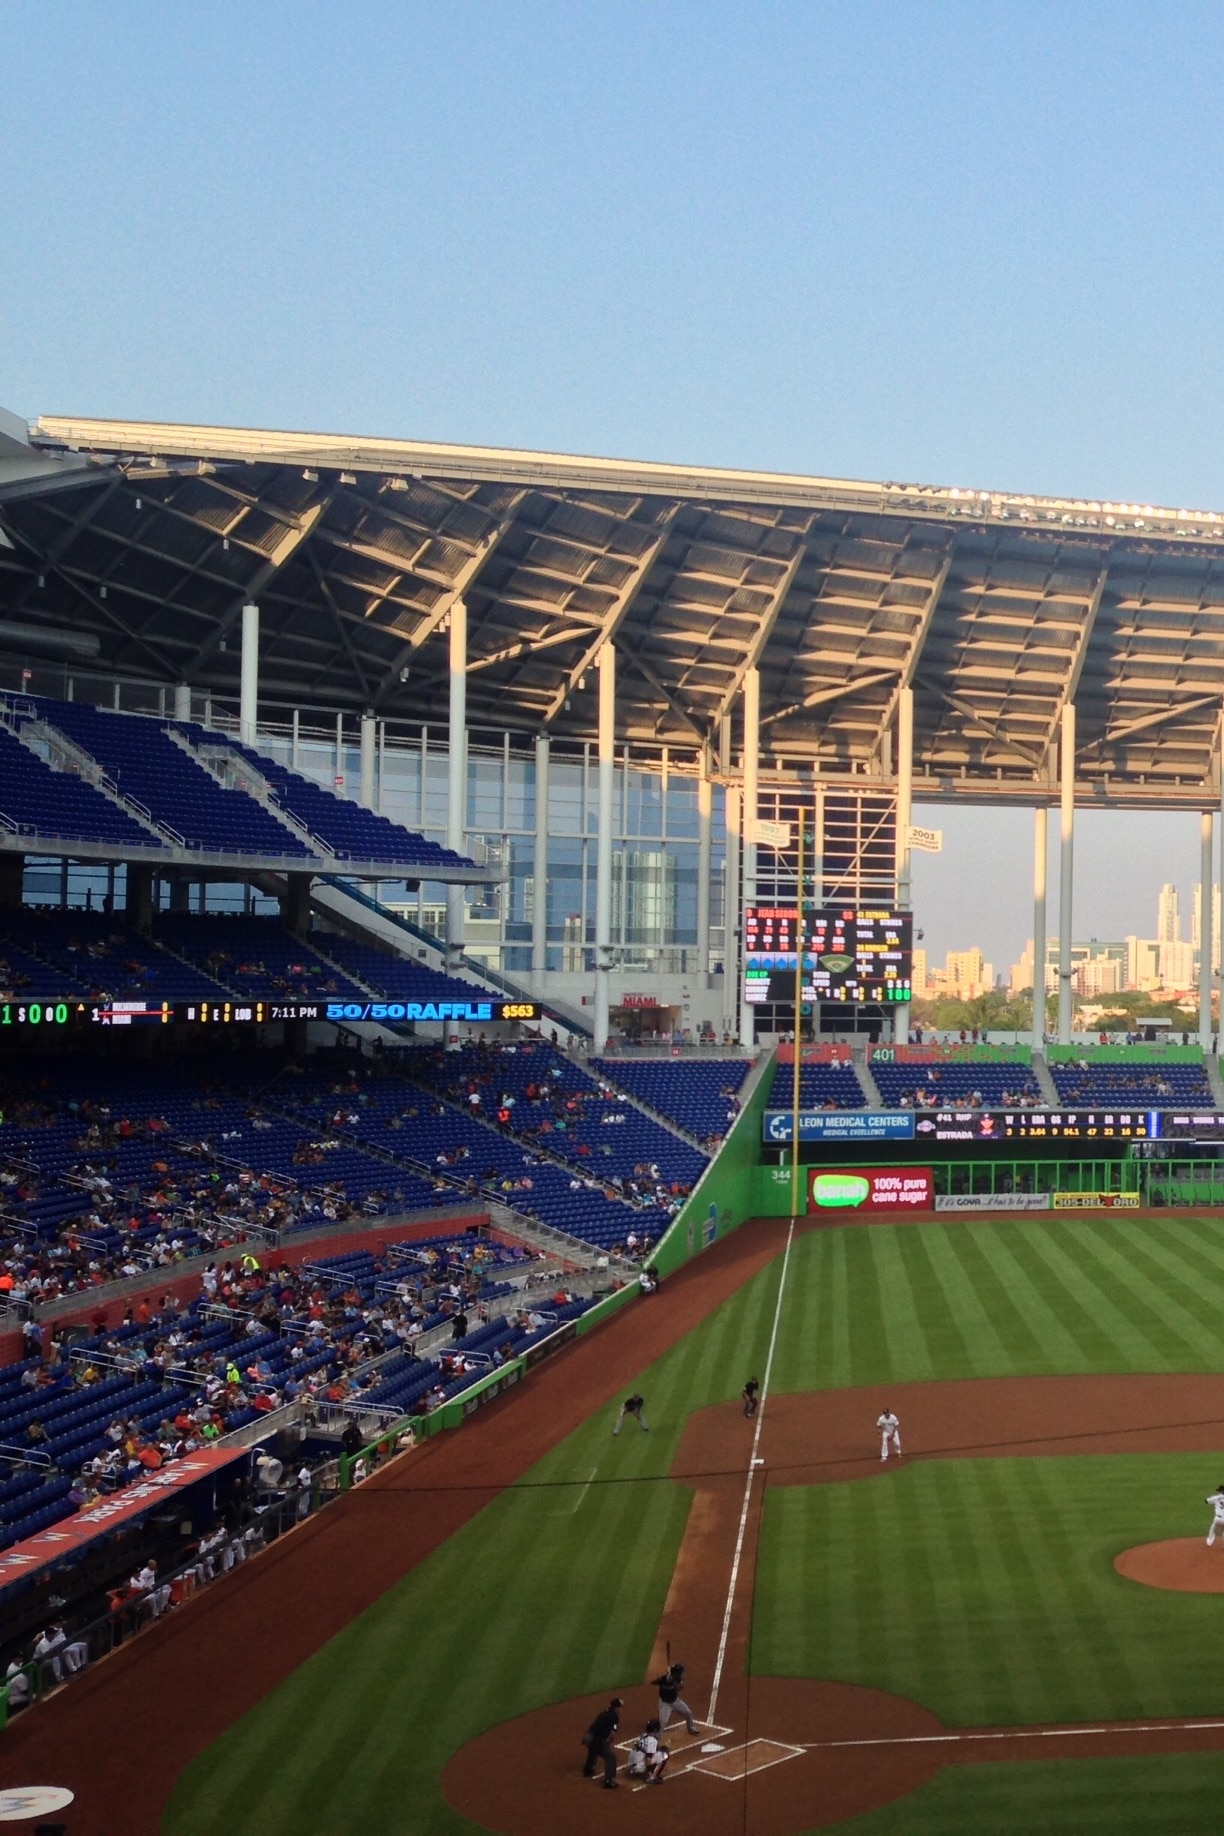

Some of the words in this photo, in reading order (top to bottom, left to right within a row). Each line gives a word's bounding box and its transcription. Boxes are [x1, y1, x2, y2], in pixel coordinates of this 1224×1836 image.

[912, 829, 935, 840] 2003
[624, 997, 656, 1007] MIAMI
[2, 1005, 12, 1024] 1
[18, 1007, 26, 1022] S
[91, 1008, 100, 1021] 1
[272, 1007, 296, 1018] 7:11
[300, 1007, 317, 1018] PM
[327, 1003, 405, 1020] 50/50
[407, 1003, 492, 1019] RAFFLE
[502, 1004, 534, 1019] $563
[873, 1049, 894, 1060] 401
[800, 1117, 823, 1128] LEON
[825, 1117, 866, 1127] MEDICAL
[868, 1116, 909, 1127] CENTERS
[1005, 1115, 1014, 1125] W
[936, 1131, 973, 1139] ESTRADA
[771, 1171, 791, 1180] 344
[874, 1178, 902, 1190] 100%
[904, 1178, 927, 1191] pure
[872, 1192, 897, 1203] cane
[899, 1190, 928, 1204] sugar
[1113, 1198, 1139, 1207] ORO
